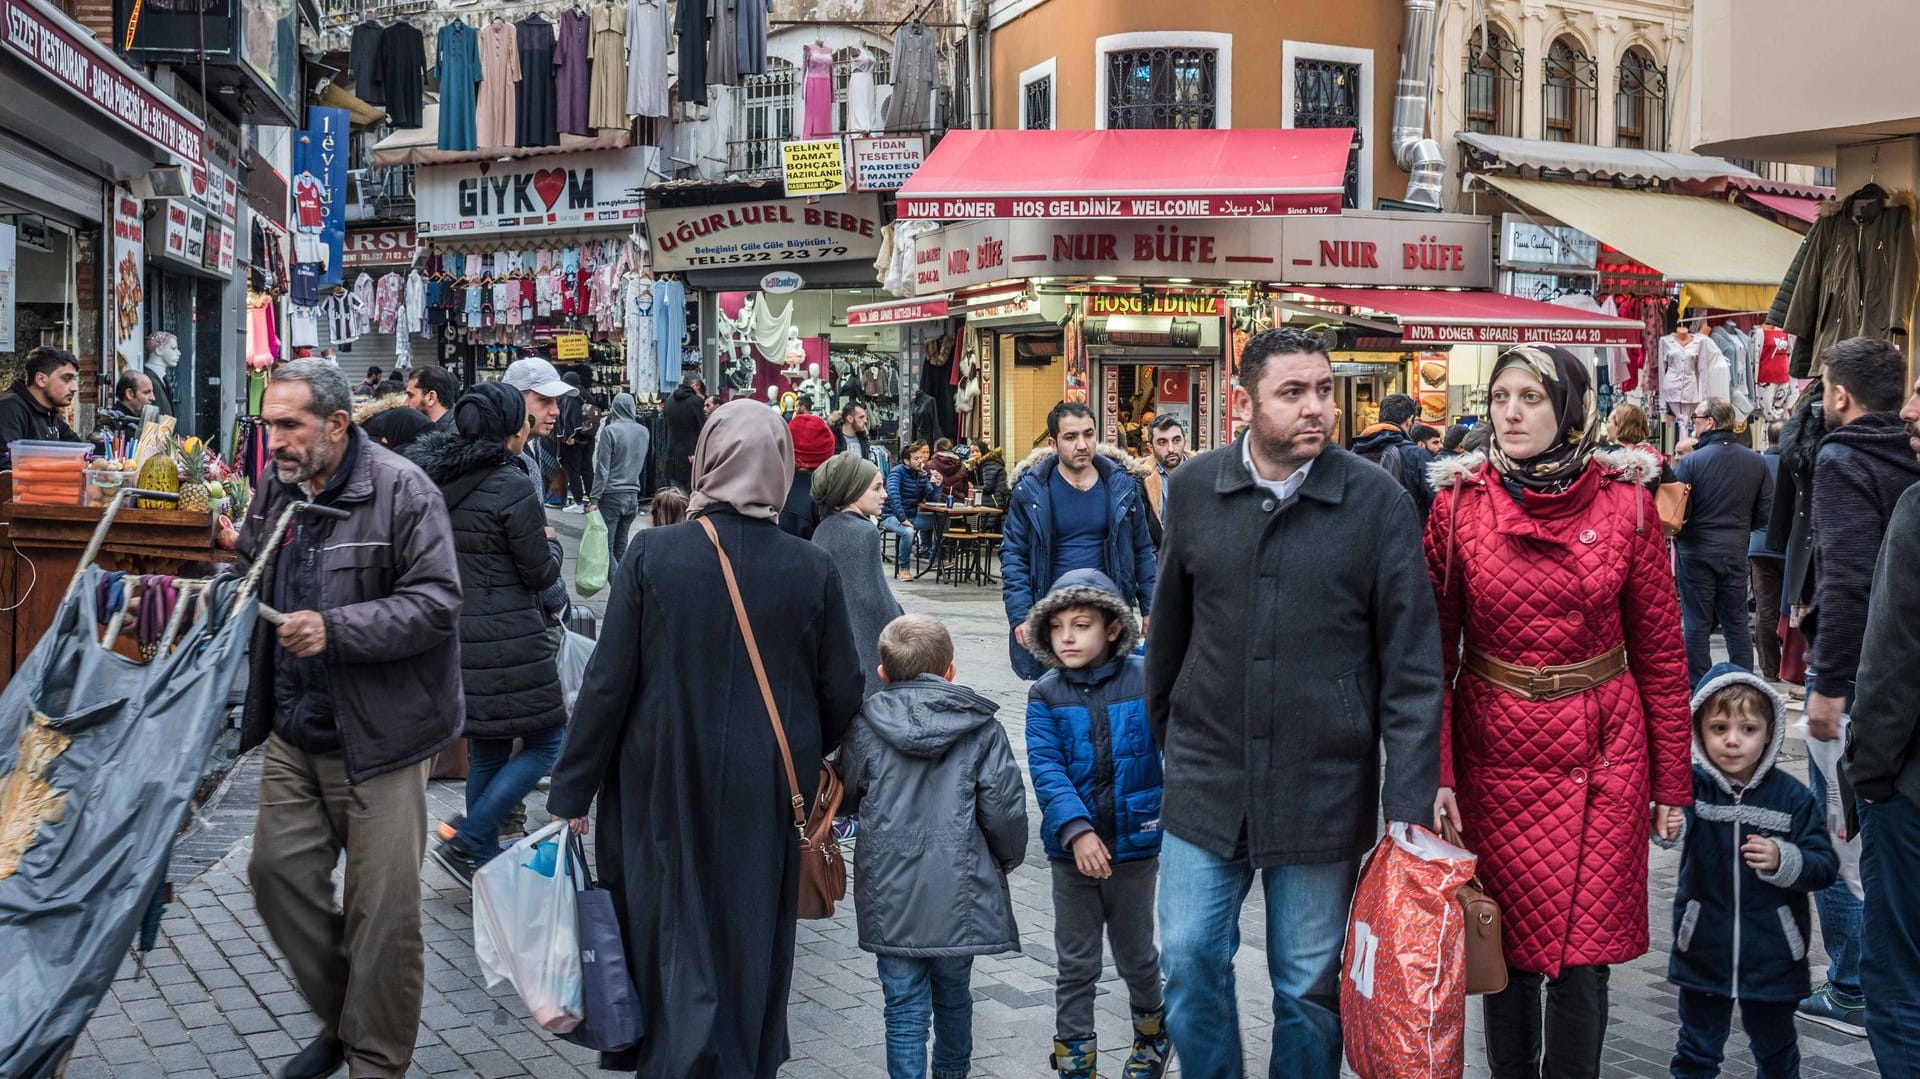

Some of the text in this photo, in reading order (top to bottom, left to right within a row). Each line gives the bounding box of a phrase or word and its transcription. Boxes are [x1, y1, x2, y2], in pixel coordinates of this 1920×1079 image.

[6, 1, 39, 58] LEZZET
[40, 24, 88, 92] RESTAURANT
[93, 65, 114, 110] BAFRA
[784, 142, 840, 153] GELİN VE
[792, 152, 832, 161] DAMAT
[859, 149, 919, 161] TESETTÜR
[786, 160, 841, 171] BOHÇASI
[860, 162, 920, 171] PARDESÜ
[786, 169, 843, 180] HAZIRLANIR
[908, 198, 1210, 218] NUR DÖNER HOŞ GELDİNİZ WELCOME
[1287, 206, 1329, 214] Since 1987
[658, 204, 876, 252] UĞURLUEL BEBE
[741, 243, 761, 252] Güle
[763, 242, 784, 250] Güle
[787, 238, 826, 249] Büyütün
[1052, 225, 1217, 263] NUR BÜFE
[780, 249, 811, 260] 23
[818, 246, 848, 257] 79
[947, 236, 1004, 276] NUR BÜFE
[1320, 234, 1465, 271] NUR BÜFE
[1411, 326, 1435, 340] NUR
[1480, 325, 1519, 343] SİPARİŞ
[1575, 328, 1587, 341] 44
[1589, 328, 1601, 342] 20
